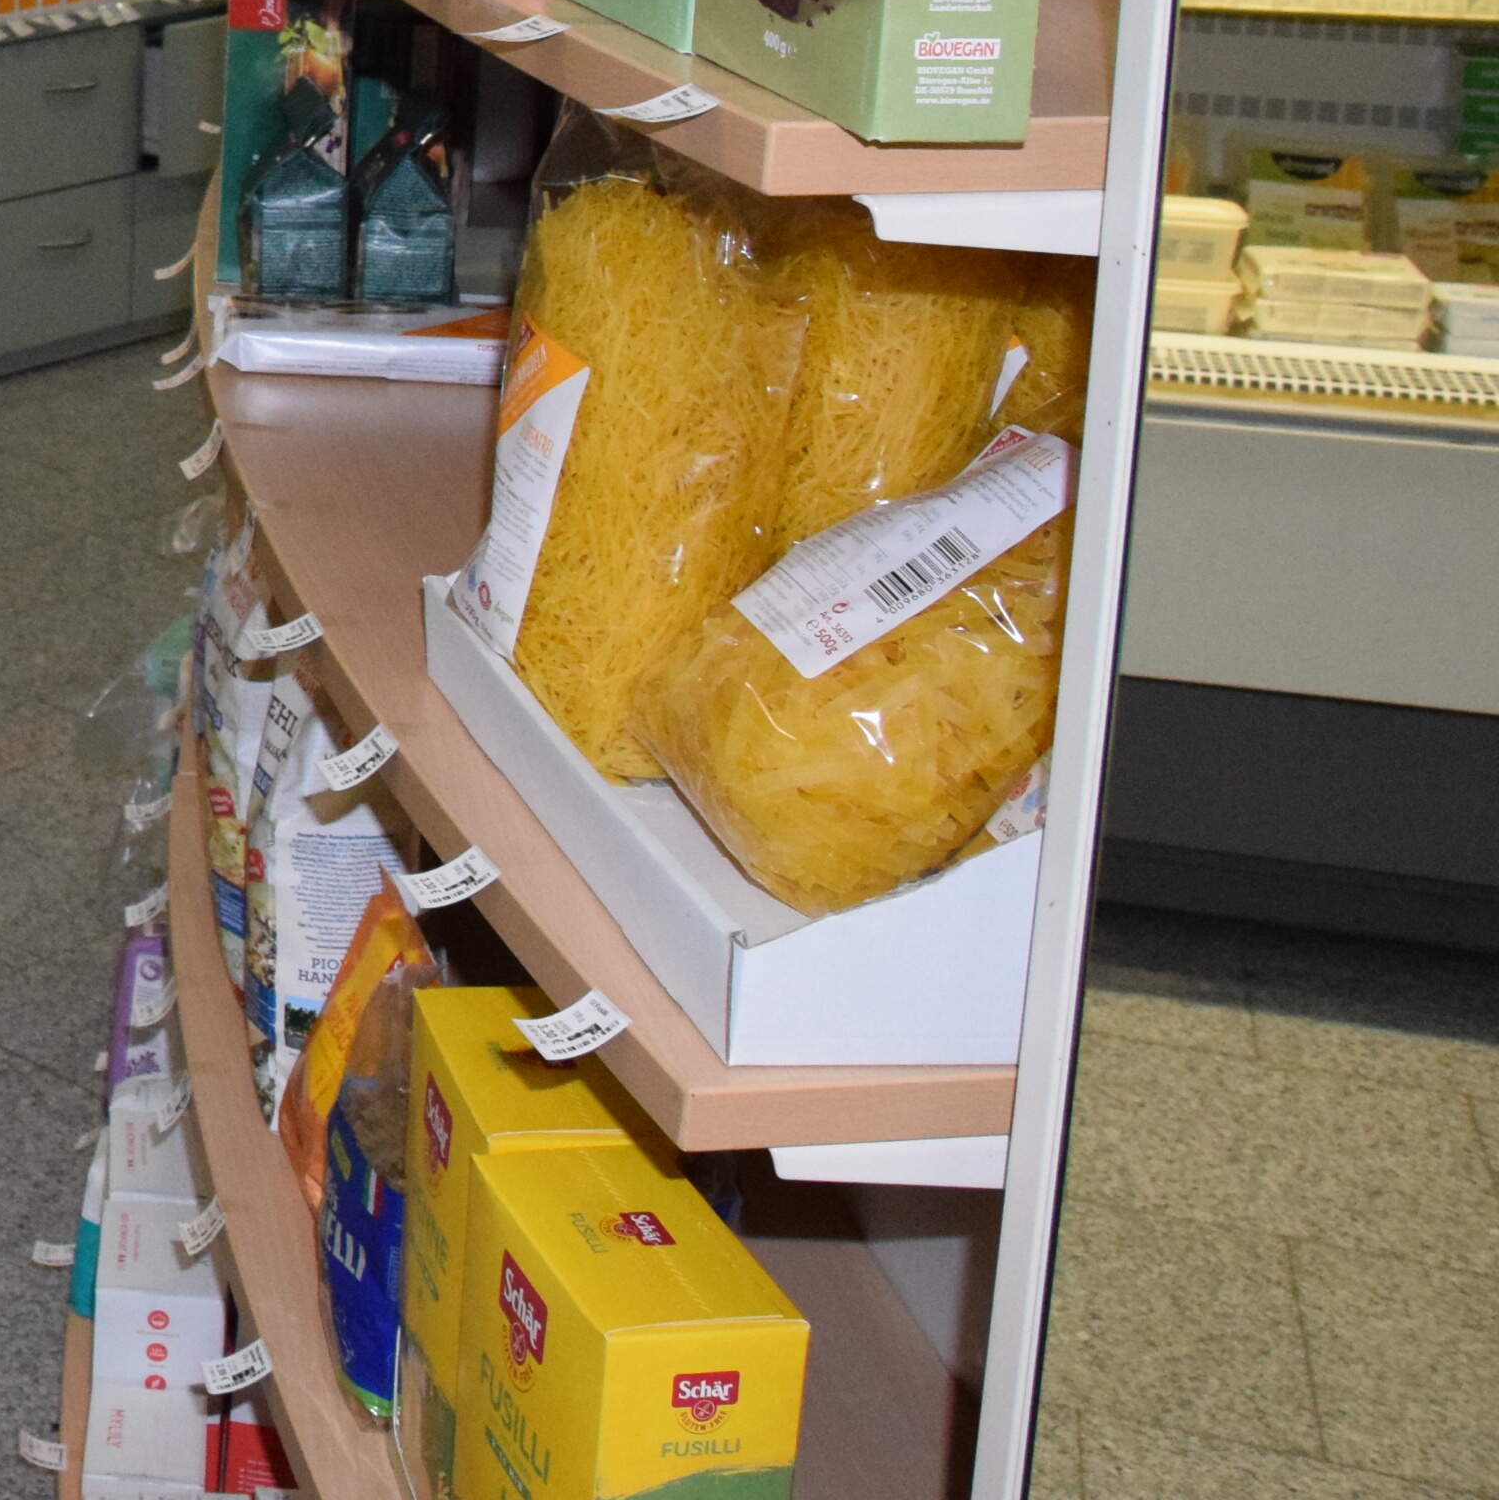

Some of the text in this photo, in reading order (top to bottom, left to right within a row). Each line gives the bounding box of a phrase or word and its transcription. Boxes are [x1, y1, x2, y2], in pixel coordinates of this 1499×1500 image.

[918, 41, 995, 57] BIOVEGAN
[569, 1211, 610, 1255] FUSILLI
[630, 1212, 663, 1245] Schär
[503, 1267, 542, 1350] Schär
[677, 1379, 734, 1401] Schär
[480, 1351, 551, 1486] FUSILLI
[660, 1438, 742, 1458] FUSILLI
